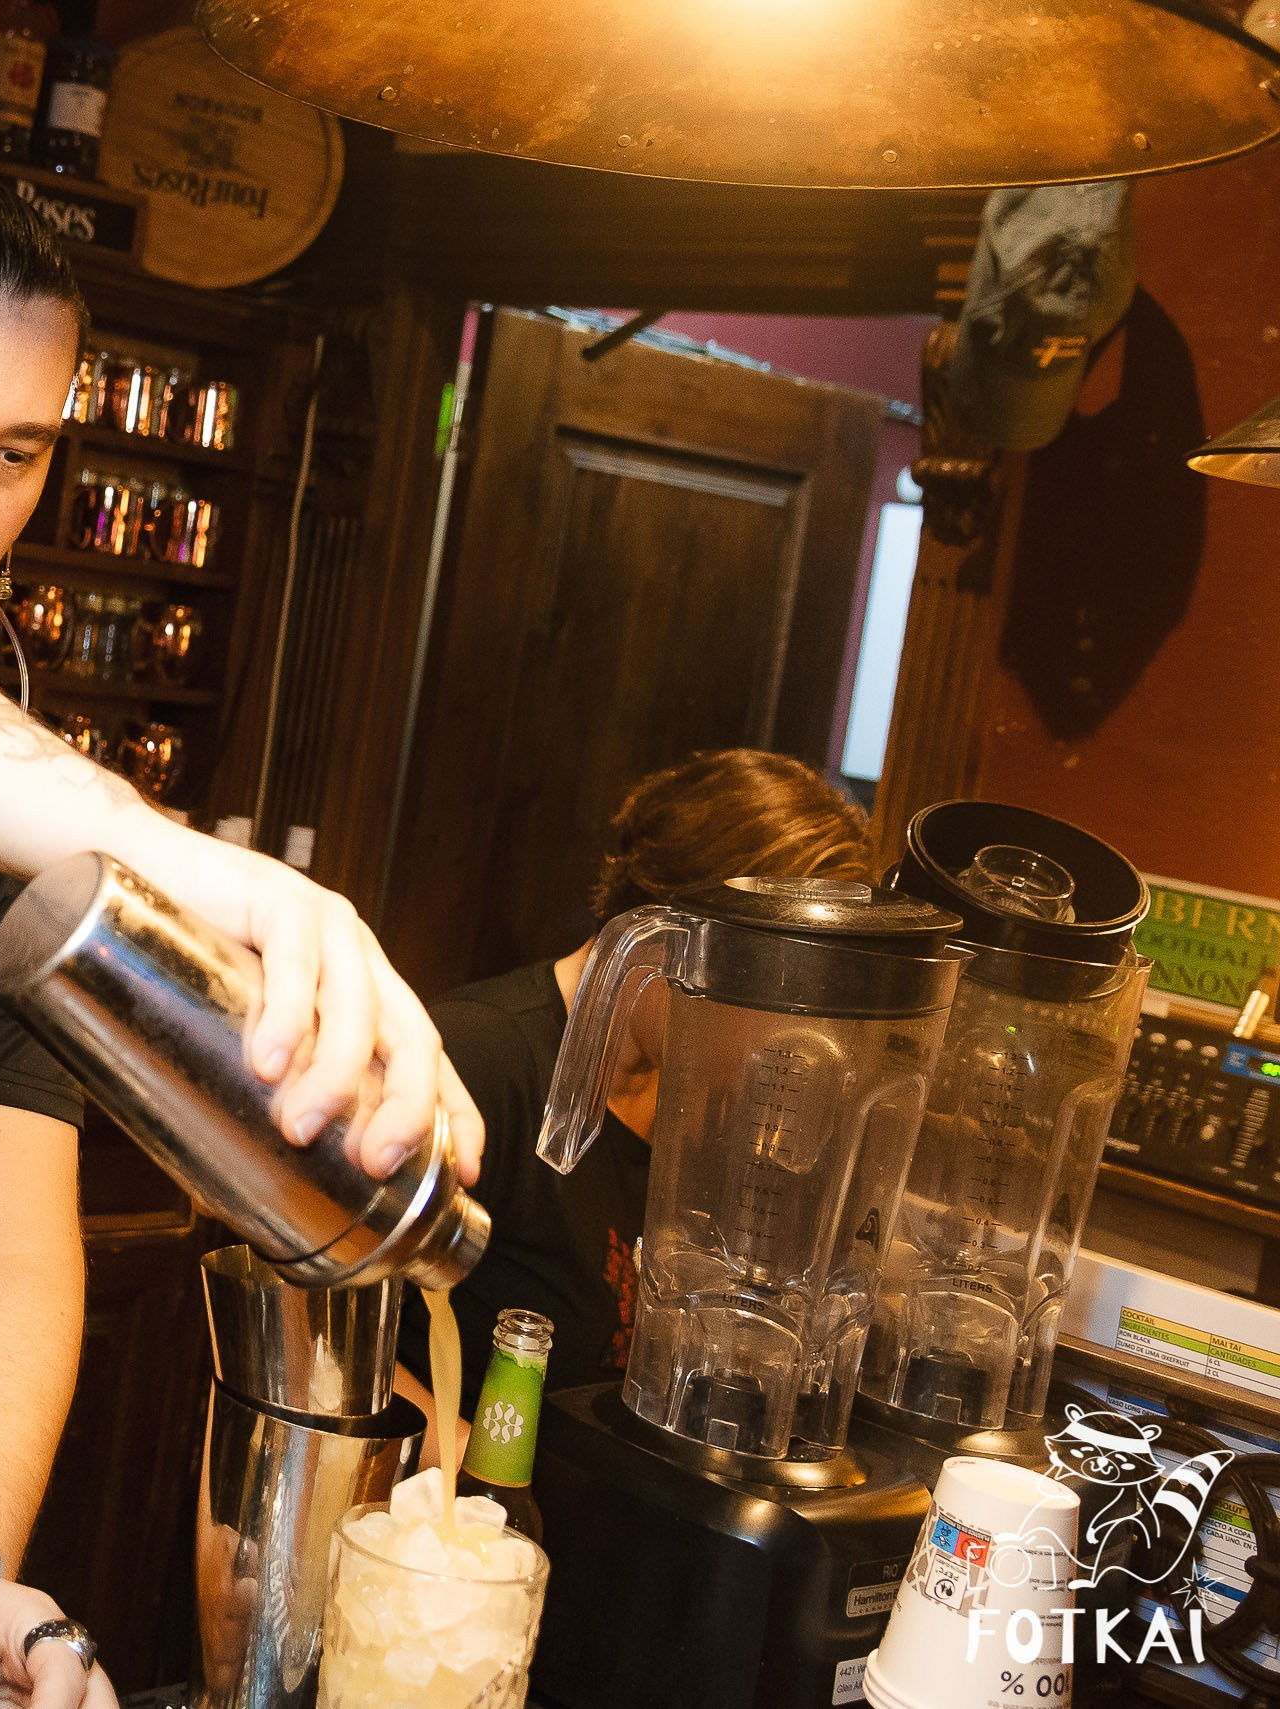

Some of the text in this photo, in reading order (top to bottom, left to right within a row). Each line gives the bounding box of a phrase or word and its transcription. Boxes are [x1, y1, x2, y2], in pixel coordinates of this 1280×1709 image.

[952, 1278, 993, 1293] LITERS
[723, 1292, 766, 1311] LITERS
[1122, 1309, 1242, 1352] COCKTAIL MAI TAI
[1121, 1320, 1258, 1369] INGREDIENTES CANTIDADES
[1133, 1333, 1151, 1345] BLACK
[1145, 1348, 1160, 1359] LIMA
[1124, 1403, 1141, 1414] LONG
[1206, 1528, 1224, 1540] CADA
[1243, 1542, 1252, 1550] EN
[1233, 1528, 1252, 1540] COPA
[853, 1590, 893, 1607] Hamilton
[839, 1666, 856, 1677] 4421
[837, 1682, 853, 1694] Glen
[1000, 1670, 1024, 1696] %
